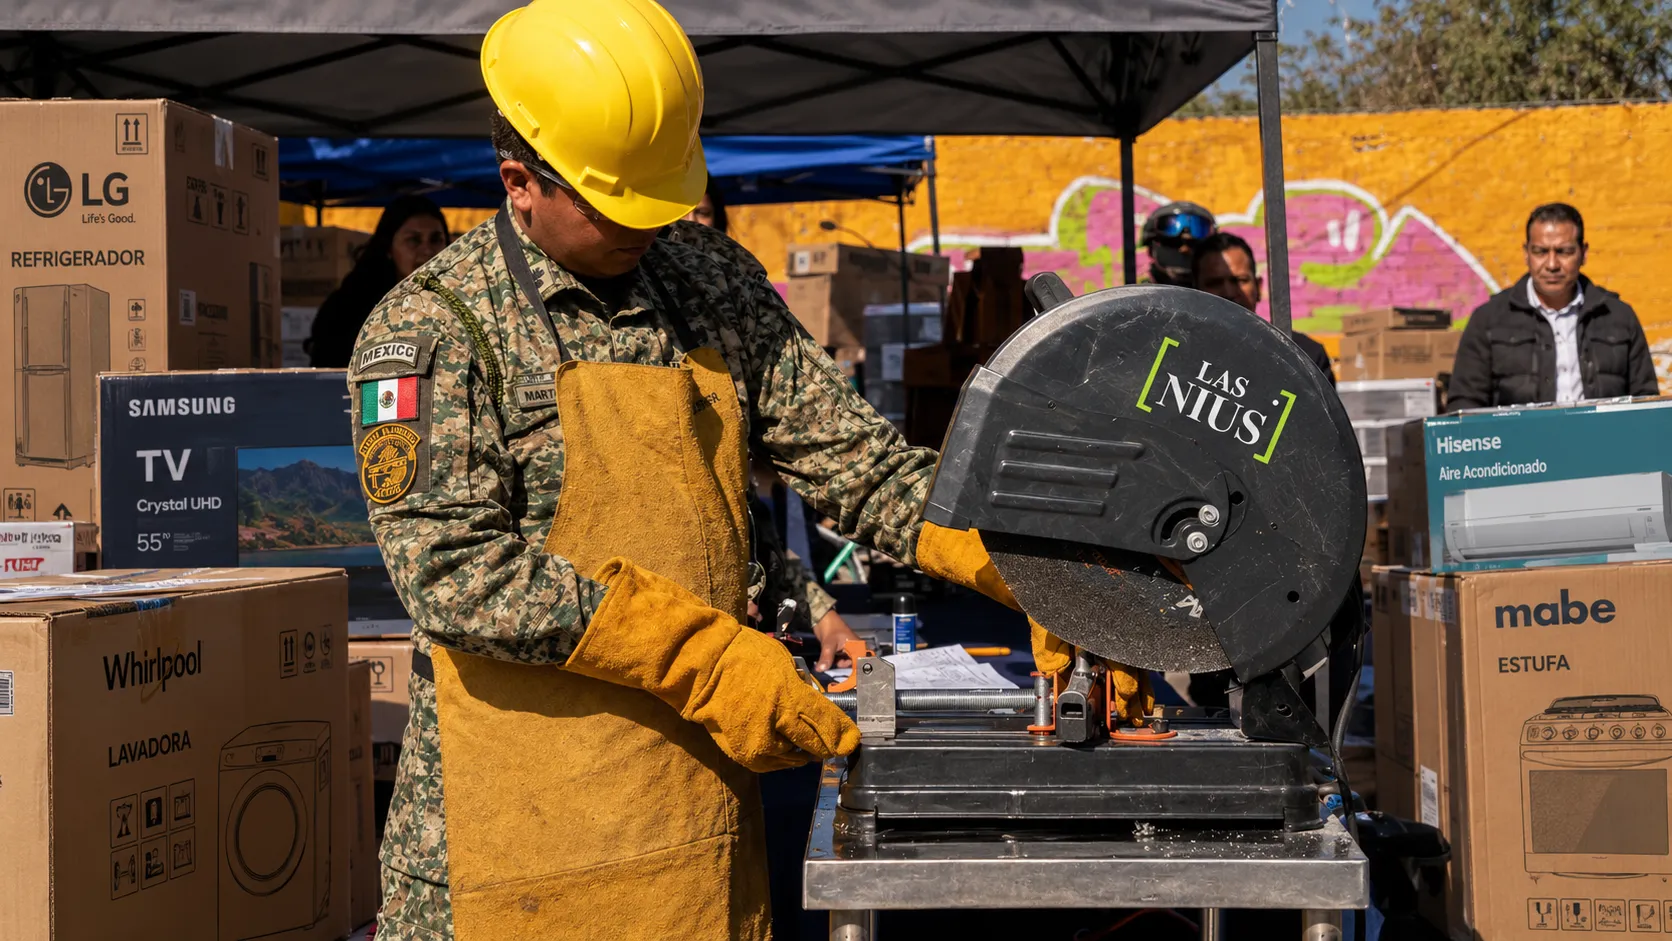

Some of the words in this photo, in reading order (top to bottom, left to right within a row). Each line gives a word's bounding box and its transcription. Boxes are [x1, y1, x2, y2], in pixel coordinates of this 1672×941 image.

[82, 172, 129, 206] LG
[82, 213, 105, 224] Life's
[108, 213, 136, 224] Good.
[11, 250, 145, 268] REFRIGERADOR
[1196, 360, 1249, 398] LAS
[129, 396, 236, 417] SAMSUNG
[1155, 372, 1268, 445] NIUS
[1437, 435, 1501, 454] Hisense
[136, 449, 191, 482] TV
[1439, 466, 1461, 481] Aire
[1463, 459, 1547, 479] Acondicionado
[137, 498, 187, 515] Crystal
[190, 496, 222, 510] UHD
[1495, 589, 1616, 628] mabe
[103, 640, 202, 692] Whirlpool
[1498, 655, 1570, 673] ESTUFA
[108, 730, 191, 767] LAVADORA
